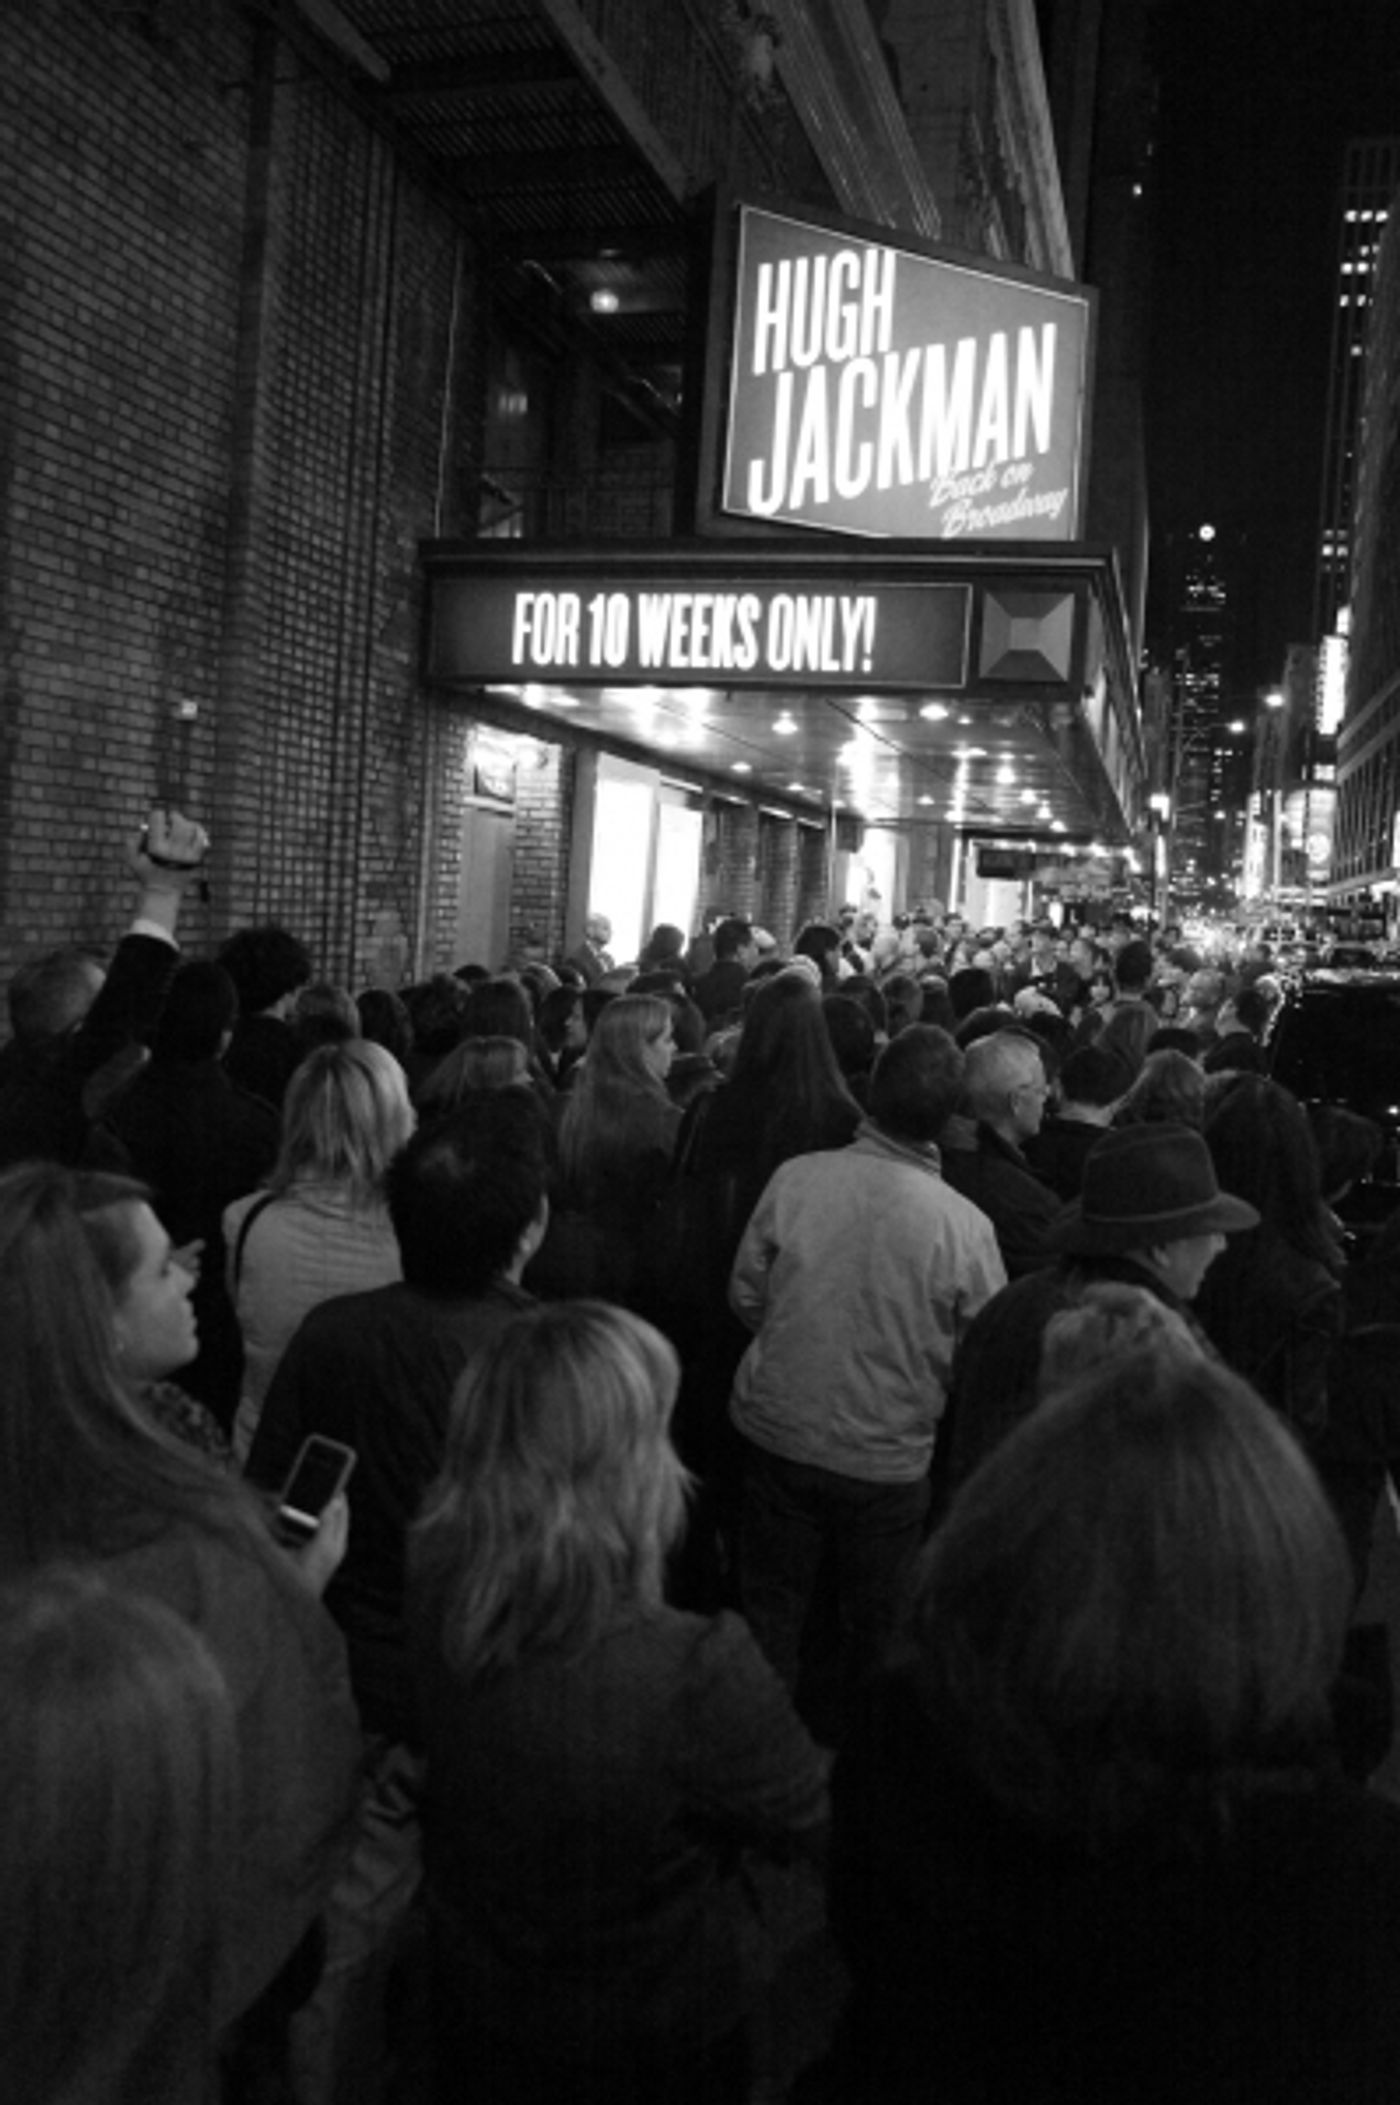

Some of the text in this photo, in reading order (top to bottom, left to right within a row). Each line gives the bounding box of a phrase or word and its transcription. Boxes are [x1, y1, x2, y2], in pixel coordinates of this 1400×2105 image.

[753, 248, 896, 376] HUGH
[747, 323, 1057, 517] JACKMAN
[929, 462, 1034, 508] Back on
[940, 486, 1069, 541] Broadway
[511, 592, 877, 672] FOR 10 WEEKS ONLY!
